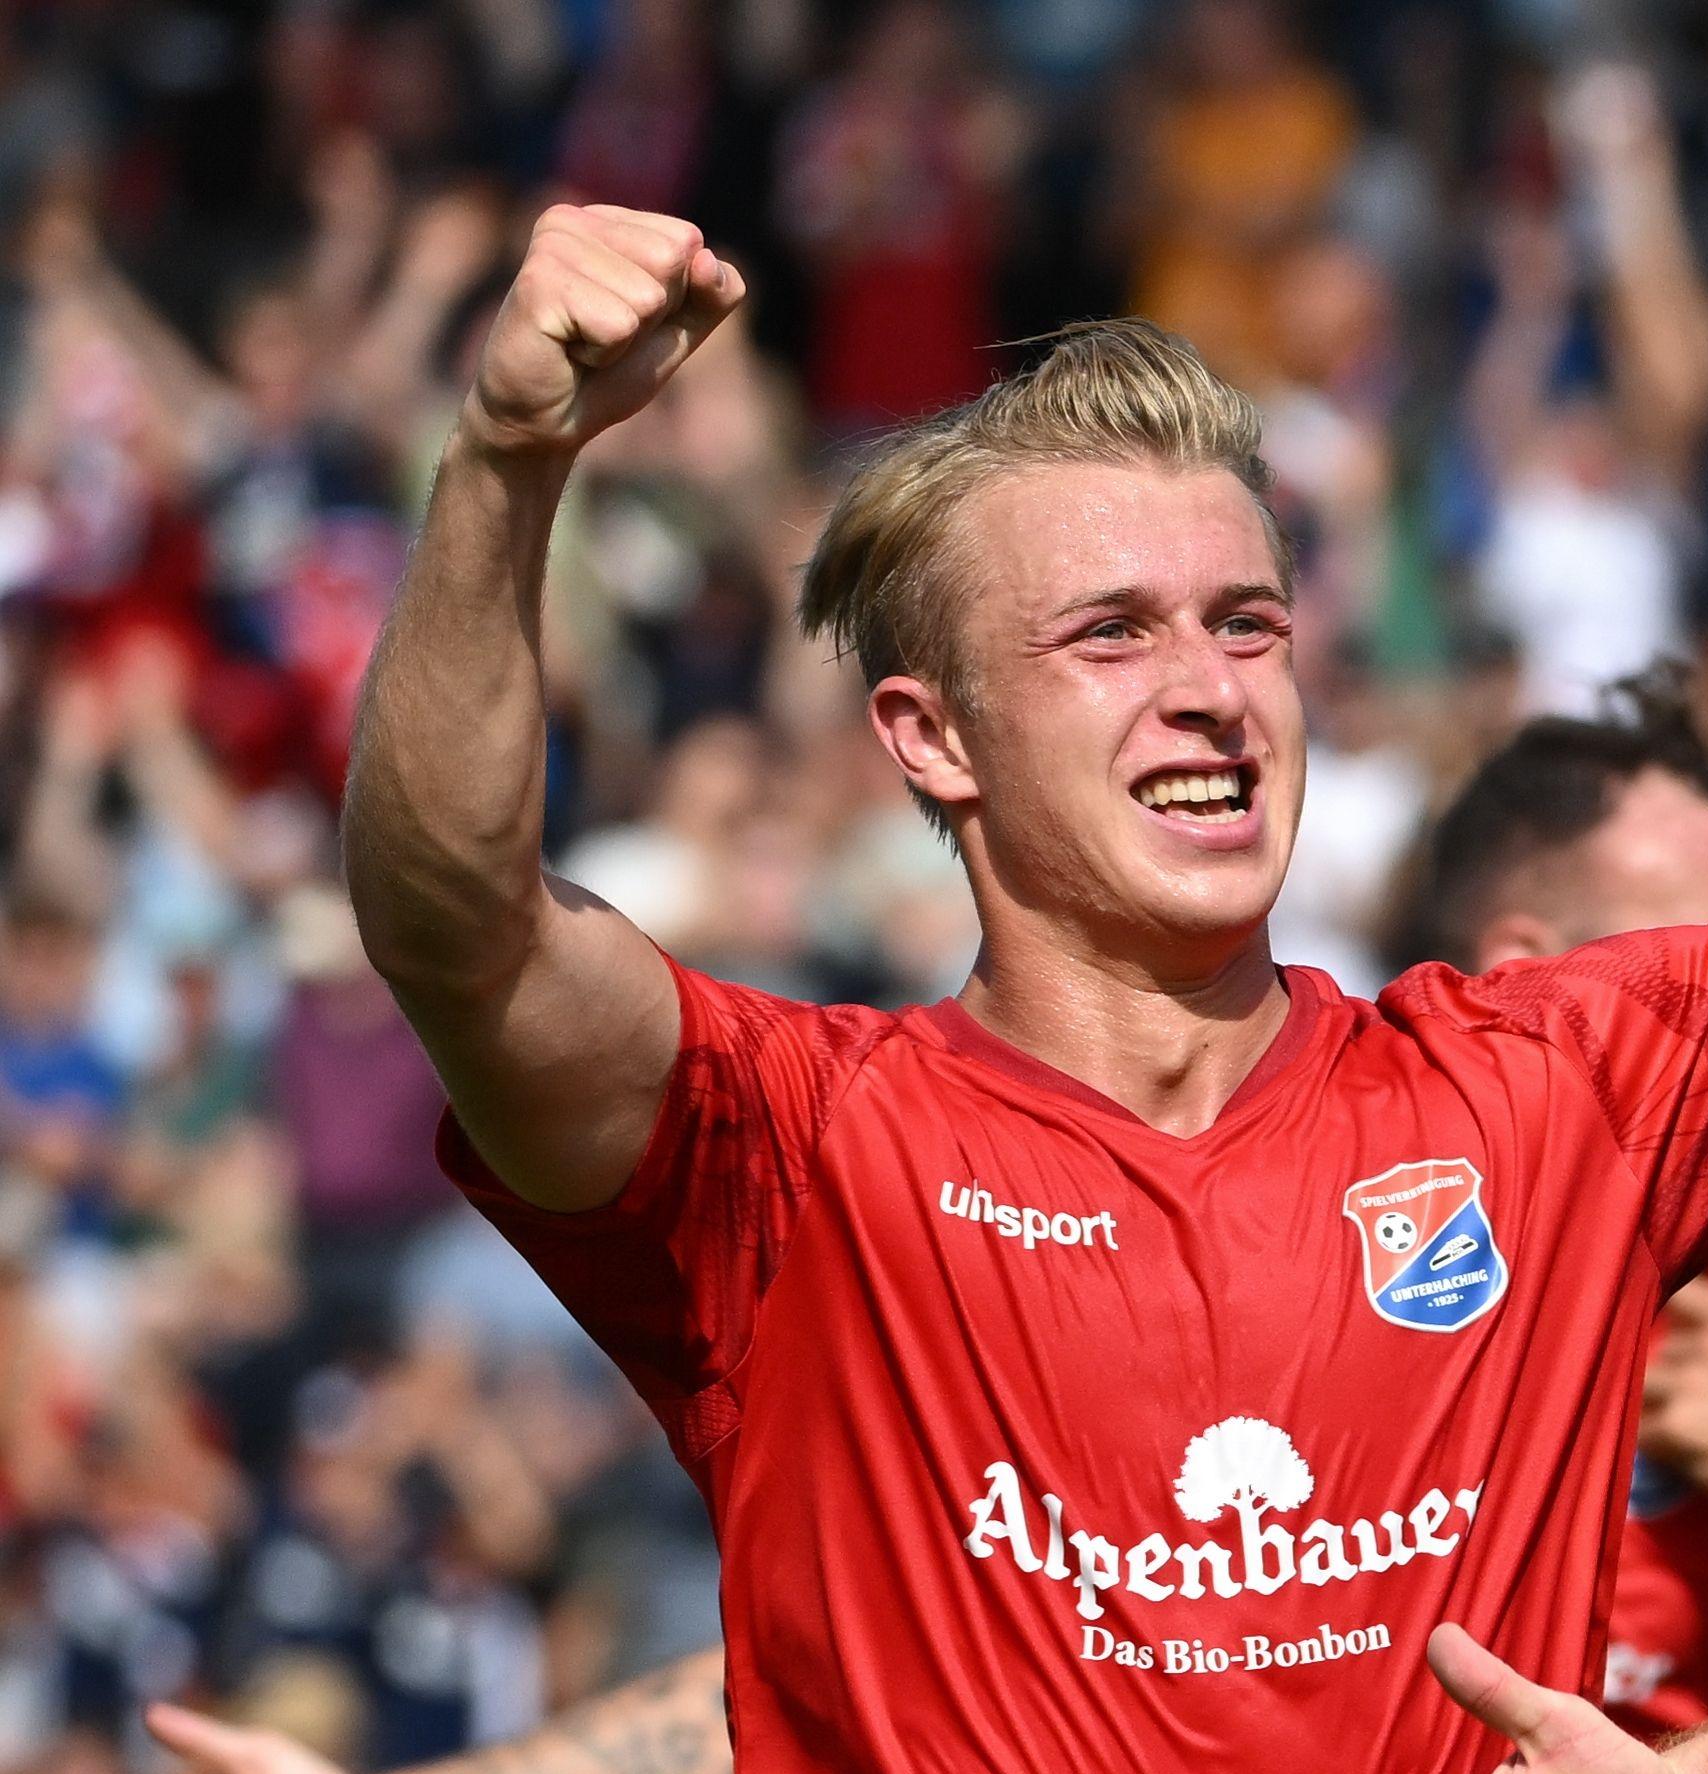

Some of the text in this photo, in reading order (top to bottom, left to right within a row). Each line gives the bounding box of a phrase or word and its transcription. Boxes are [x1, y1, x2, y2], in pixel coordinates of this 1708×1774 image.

[939, 1178, 1120, 1251] uhsport
[1390, 1268, 1489, 1303] UNTERHACHING
[1080, 1620, 1392, 1675] Das Bio-Bonbon
